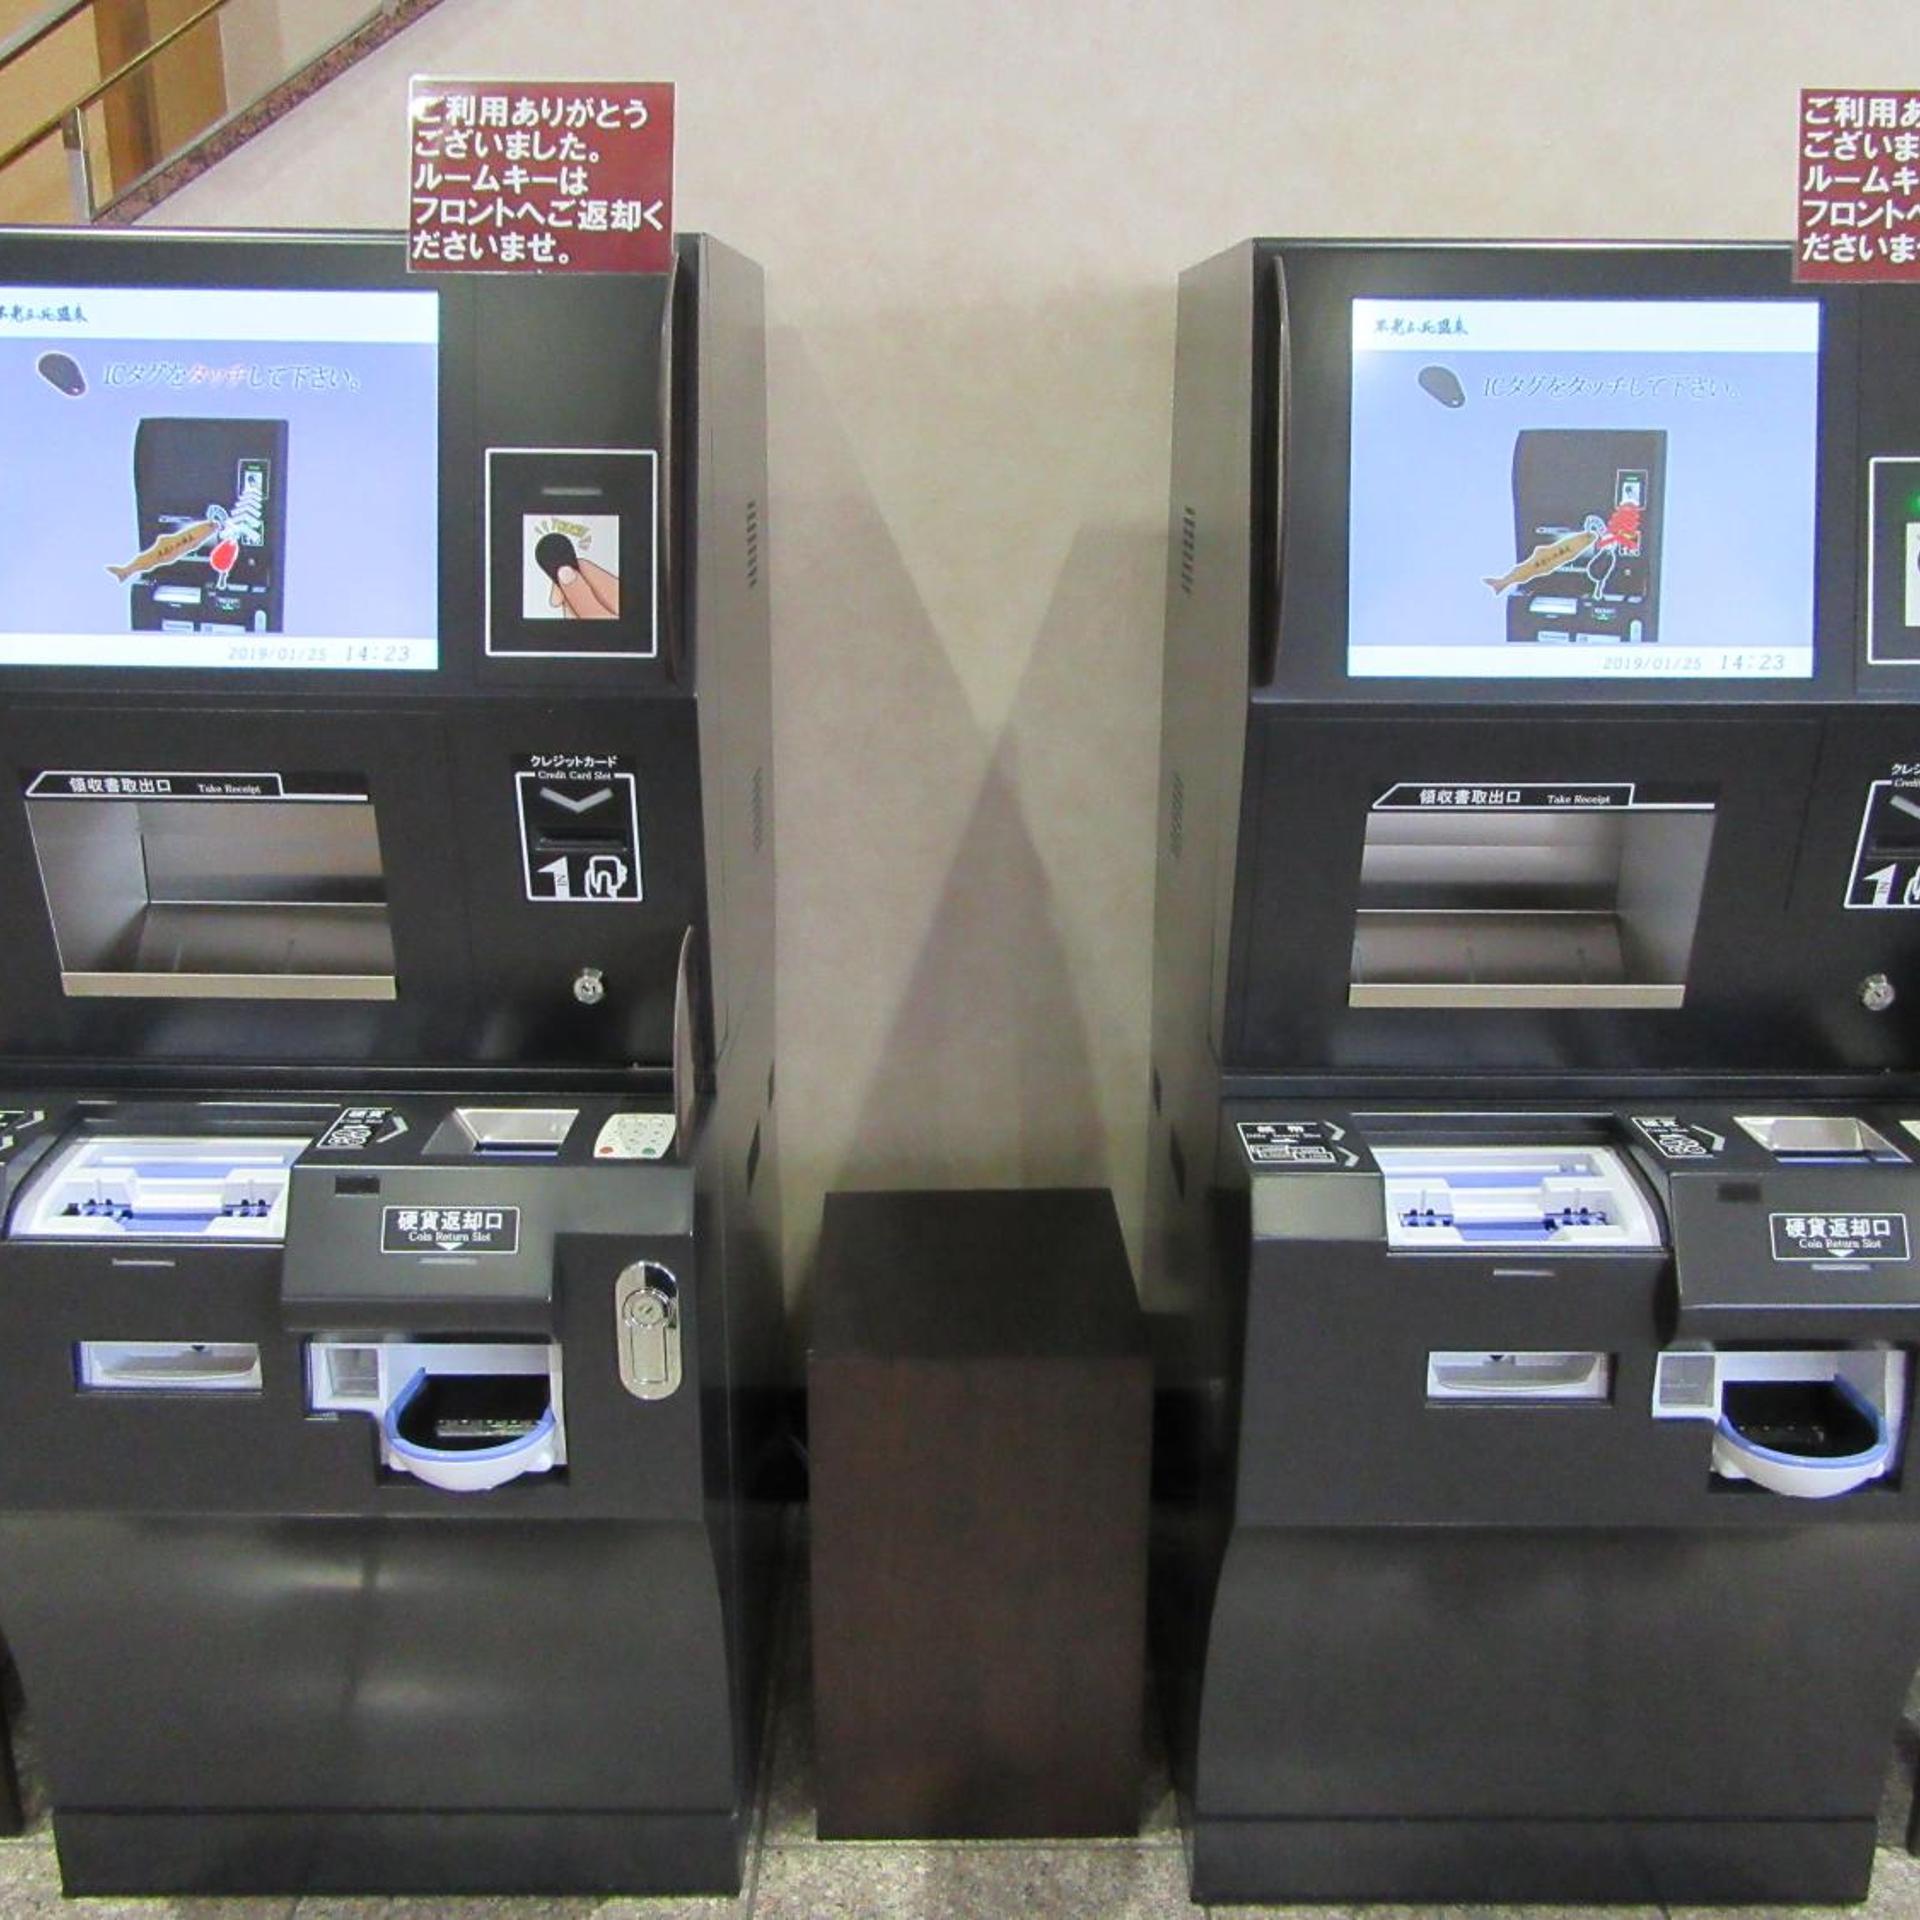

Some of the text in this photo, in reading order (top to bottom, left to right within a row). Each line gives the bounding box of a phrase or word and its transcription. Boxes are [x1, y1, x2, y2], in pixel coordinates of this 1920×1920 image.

[412, 95, 649, 129] ご利用ありがとう
[414, 130, 600, 163] ございました。
[1804, 130, 1920, 162] ございま
[414, 163, 588, 195] ルームキーは
[1804, 164, 1920, 196] ルームキ
[412, 197, 664, 231] フロントへご返却く
[412, 229, 570, 264] ださいませ。
[1801, 231, 1920, 263] ださいま
[345, 644, 411, 662] 14:23
[1602, 653, 1786, 670] 2019/01/25 14:23
[531, 754, 618, 768] クレジットカード
[69, 777, 172, 793] 領収書取出口
[568, 771, 592, 780] Card
[198, 783, 223, 793] Take
[1418, 789, 1521, 805] 領収書取出口
[1547, 794, 1611, 805] Take Receipt
[398, 1210, 503, 1231] 硬貨返却口
[1785, 1217, 1891, 1238] 硬貨返却口
